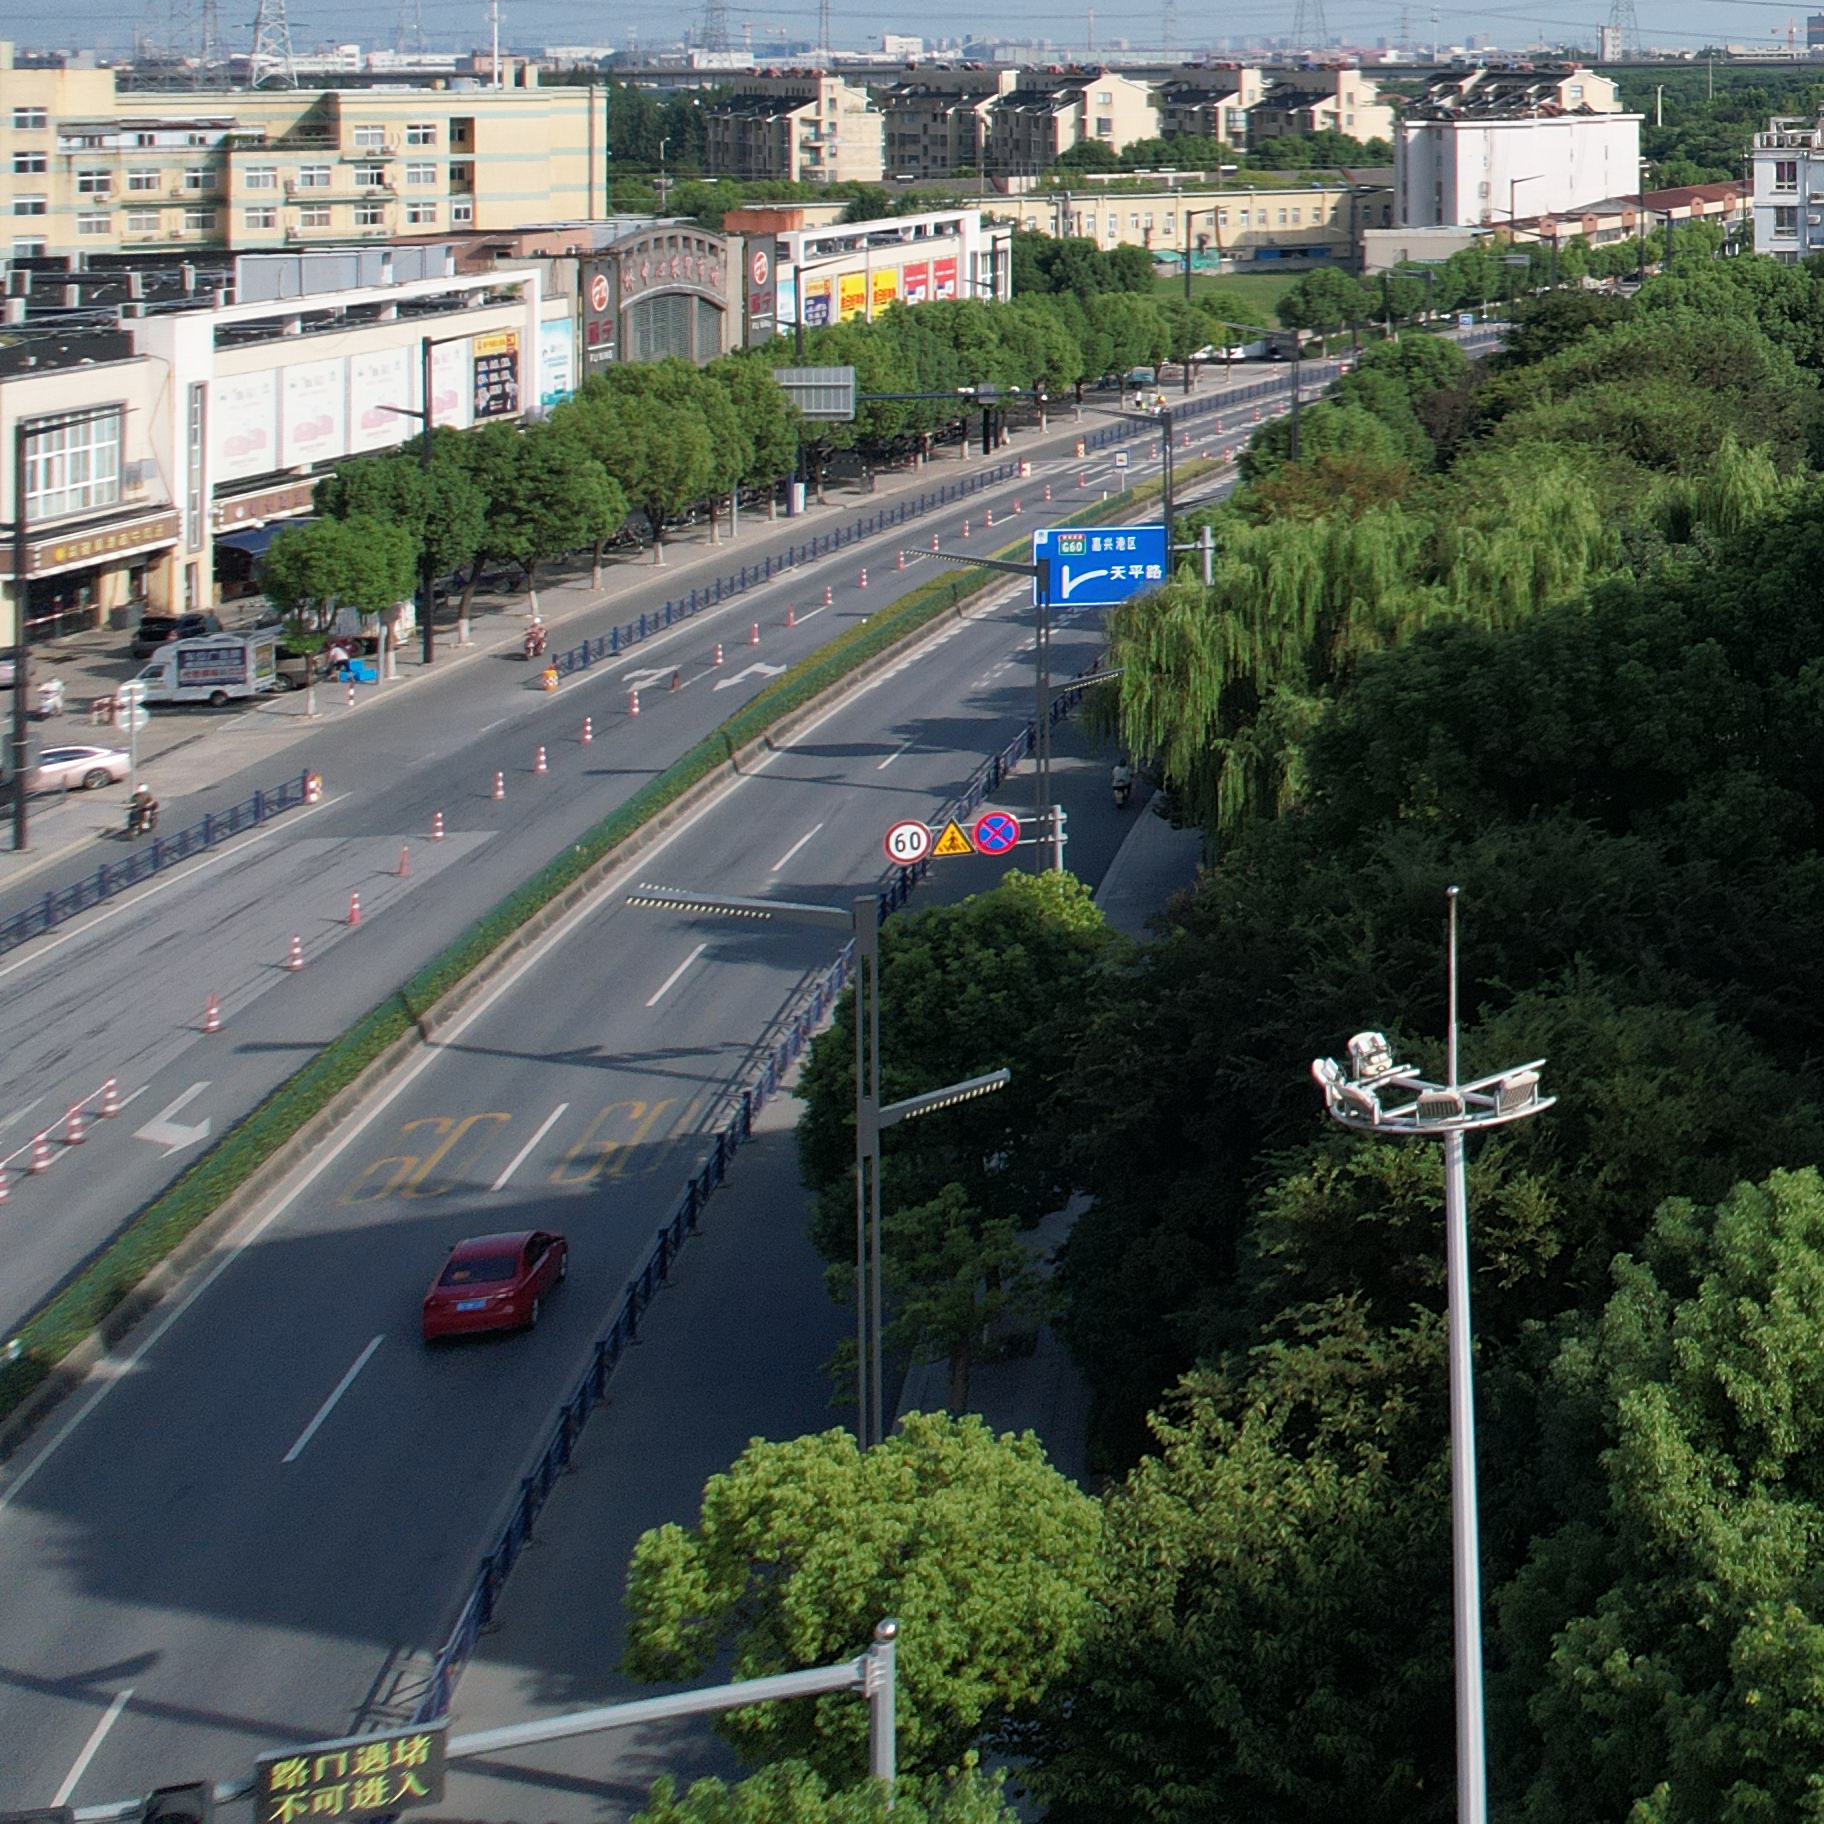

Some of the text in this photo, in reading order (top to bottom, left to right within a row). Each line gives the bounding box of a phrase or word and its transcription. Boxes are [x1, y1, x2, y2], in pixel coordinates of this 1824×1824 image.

[1062, 541, 1083, 553] G60
[1109, 564, 1163, 581] 天平路
[895, 831, 921, 853] 60
[269, 1734, 432, 1792] 路口遇堵
[267, 1770, 430, 1824] 不可进入
